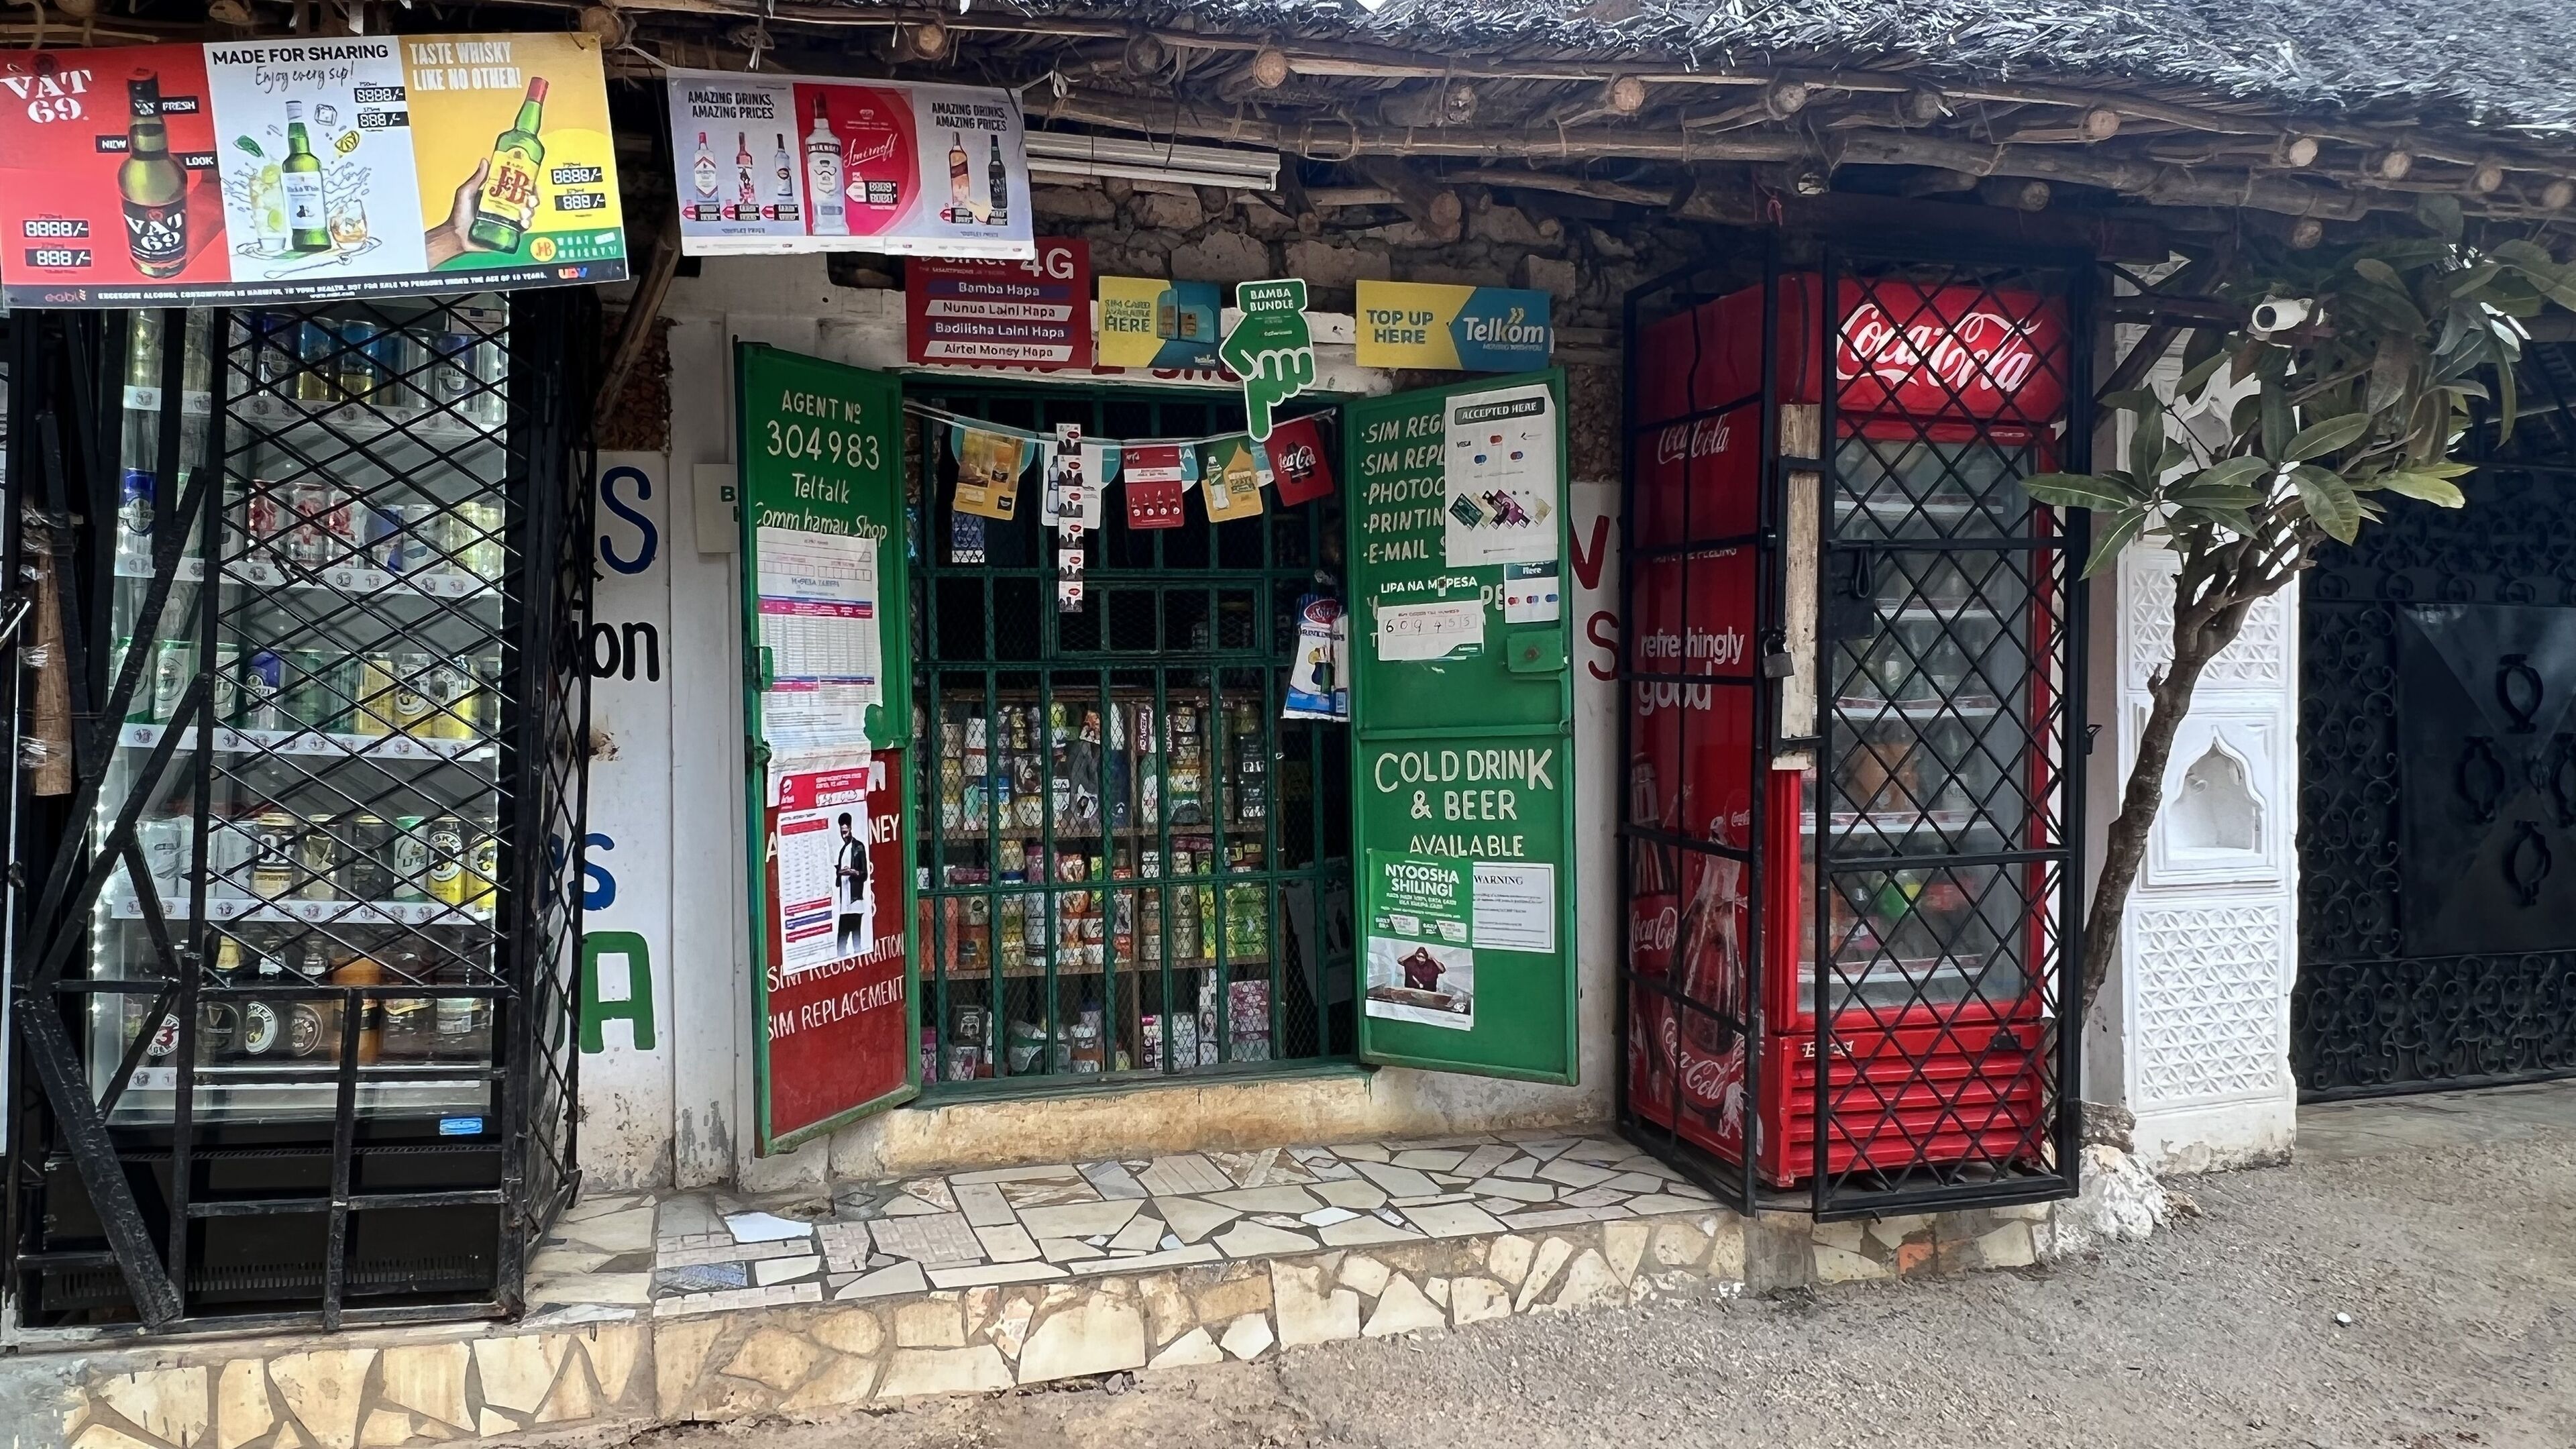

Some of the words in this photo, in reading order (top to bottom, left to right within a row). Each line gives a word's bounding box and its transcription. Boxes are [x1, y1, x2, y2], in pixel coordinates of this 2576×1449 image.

[212, 50, 266, 64] MADE
[269, 48, 304, 62] FOR
[309, 45, 388, 60] SHARING
[409, 42, 453, 65] TASTE
[455, 42, 511, 64] WHISKY
[0, 70, 92, 99] VAT
[256, 66, 288, 93] Enjoy
[292, 69, 325, 90] every
[329, 61, 354, 87] sip!
[413, 69, 446, 91] LIKE
[447, 68, 468, 90] NO
[471, 67, 523, 89] OTHER!
[162, 101, 196, 111] FRESH
[688, 91, 732, 105] AMAZING
[735, 93, 774, 108] DRINKS,
[932, 102, 971, 115] AMAZING
[692, 105, 737, 118] AMAZING
[739, 107, 774, 119] PRICES
[936, 116, 975, 129] AMAZING
[977, 119, 1007, 131] PRICES
[102, 140, 127, 149] NEW
[843, 133, 898, 167] Smirnoff
[186, 156, 213, 166] LOOK
[123, 213, 182, 235] VAT
[141, 231, 180, 250] 69
[1020, 248, 1074, 279] 4G
[959, 282, 1003, 294] Bamba
[1007, 284, 1040, 298] Hapa
[1250, 288, 1291, 299] BAMBA
[943, 302, 985, 313] Nunua
[1023, 306, 1055, 317] Hapa
[1250, 300, 1294, 312] BUNDLE
[1104, 317, 1150, 333] HERE
[1366, 309, 1403, 325] TOP
[1408, 311, 1434, 326] UP
[936, 323, 994, 335] Badilisha
[998, 325, 1028, 335] Laini
[1032, 327, 1065, 339] Hapa
[1374, 328, 1426, 344] HERE
[1463, 315, 1544, 343] Telkom
[945, 343, 976, 354] Airtel
[979, 346, 1020, 358] Money
[1023, 347, 1053, 358] Hapa
[1836, 303, 2043, 393] Coca-Cola
[782, 390, 839, 419] AGENT
[1462, 406, 1509, 419] ACCEPTED
[1511, 402, 1537, 413] HERE
[1365, 420, 1399, 443] SIM
[767, 420, 879, 470] 304983
[1364, 453, 1397, 476] SIM
[1404, 444, 1445, 470] REPL
[792, 473, 851, 504] Teltalk
[1368, 476, 1446, 504] PHOTOC
[600, 466, 658, 574] S
[853, 515, 888, 547] Shop
[1369, 507, 1445, 535] PRINTIN
[1369, 539, 1429, 564] E-MAIL
[1381, 582, 1405, 594] LIPA
[1407, 580, 1425, 591] NA
[591, 622, 660, 682] on
[1375, 751, 1459, 793] COLD
[1466, 749, 1554, 790] DRINK
[1411, 790, 1432, 819] &
[1444, 790, 1517, 821] BEER
[869, 814, 900, 845] NEY
[1409, 835, 1524, 858] AVAILABLE
[1385, 863, 1459, 884] NYOOSHA
[1473, 875, 1523, 885] WARNING
[1391, 879, 1452, 898] SHILINGI
[802, 975, 904, 1030] REPLACEMENT
